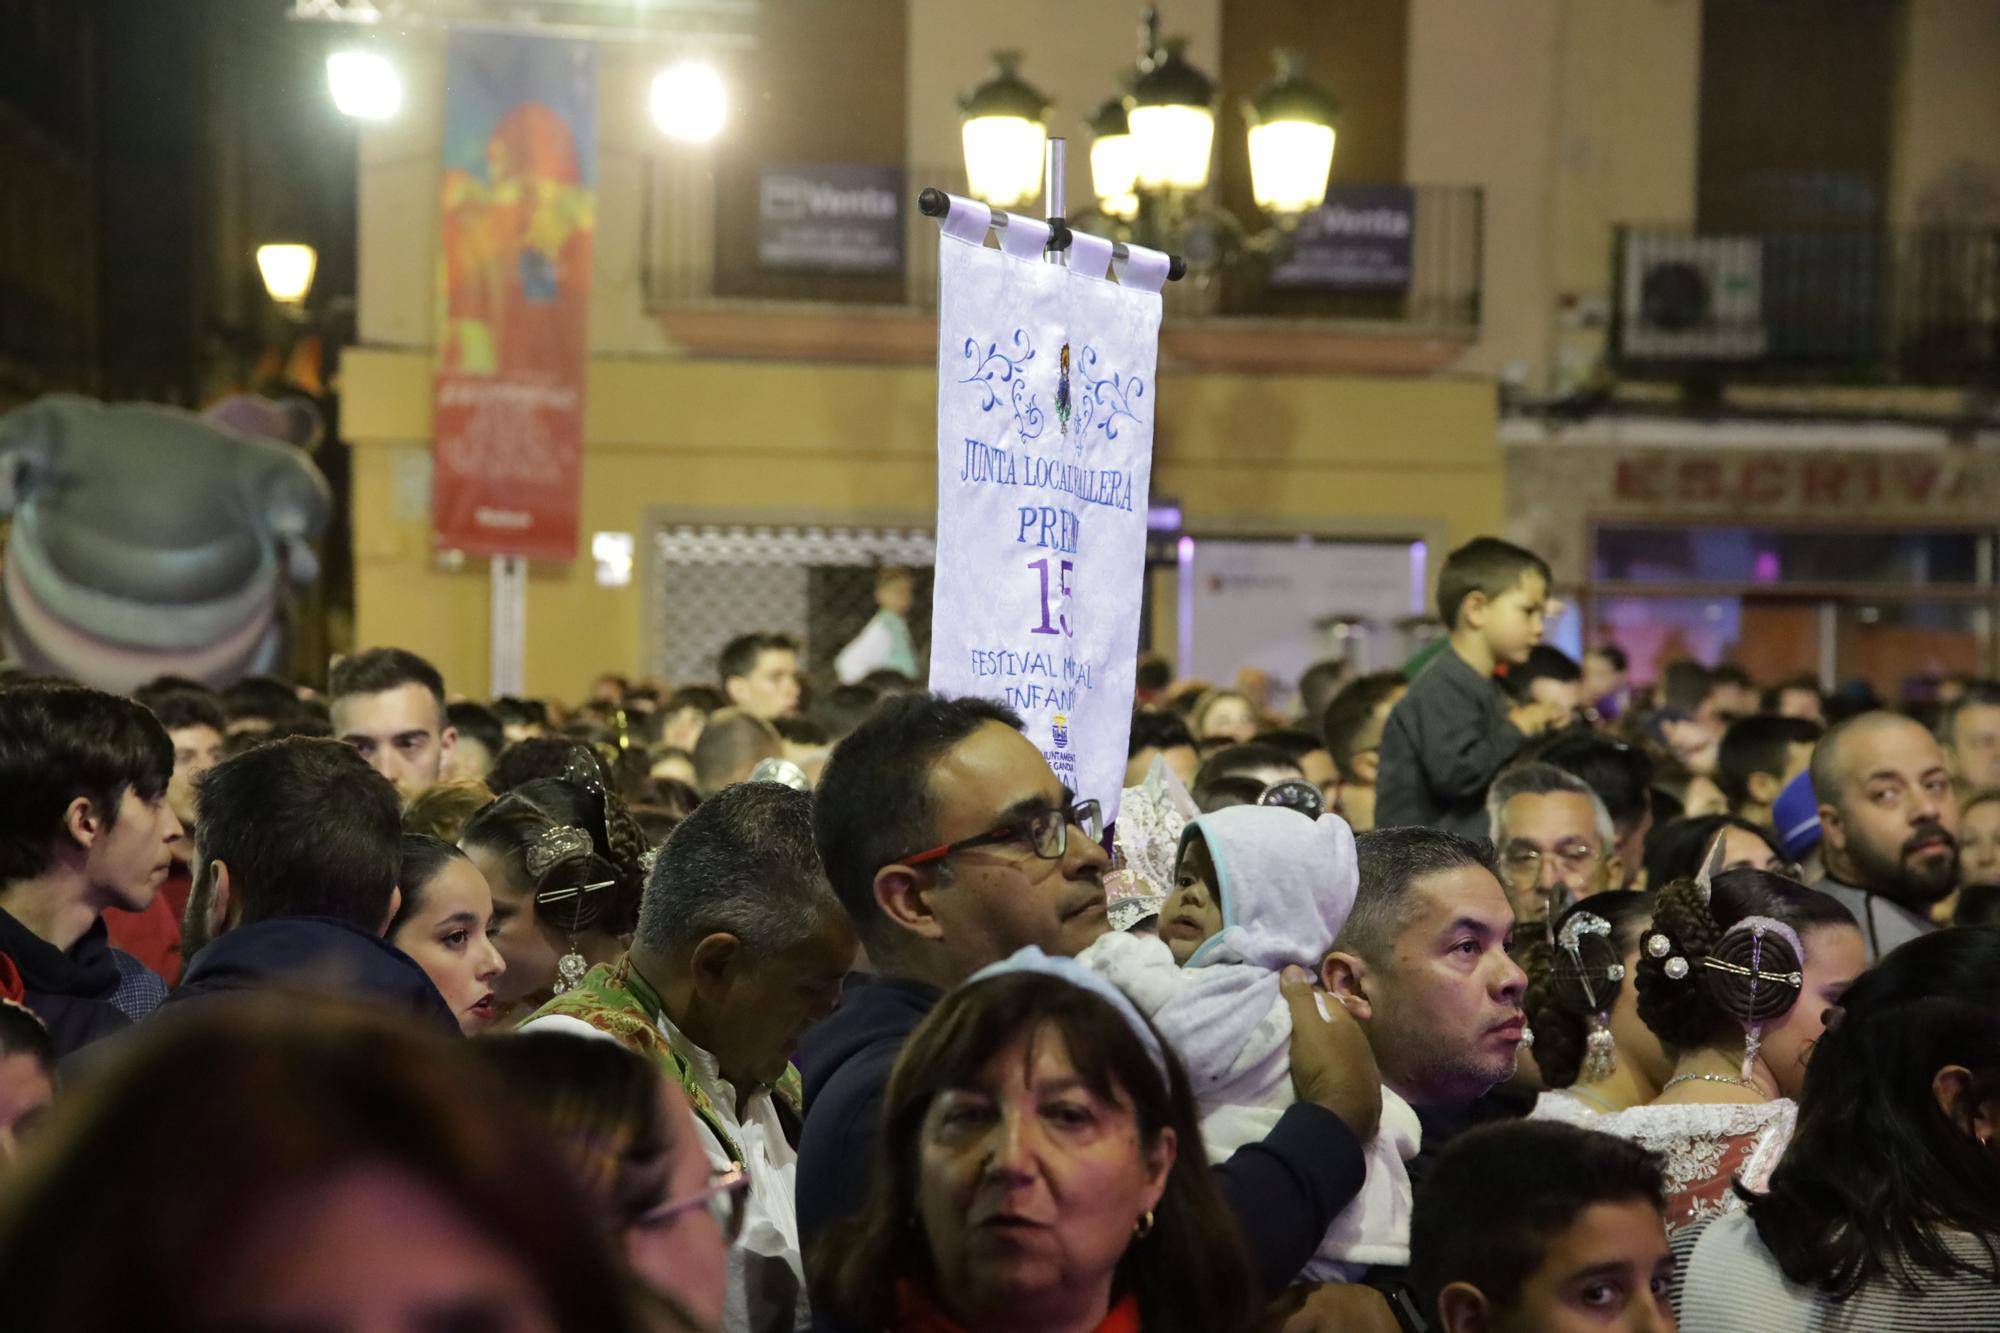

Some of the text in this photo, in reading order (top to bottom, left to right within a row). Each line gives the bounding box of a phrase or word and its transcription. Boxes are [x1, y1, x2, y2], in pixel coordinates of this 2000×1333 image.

[961, 437, 1017, 486] JUNTA
[1024, 455, 1073, 494] LOCAL
[970, 649, 1058, 678] FESTIVAL
